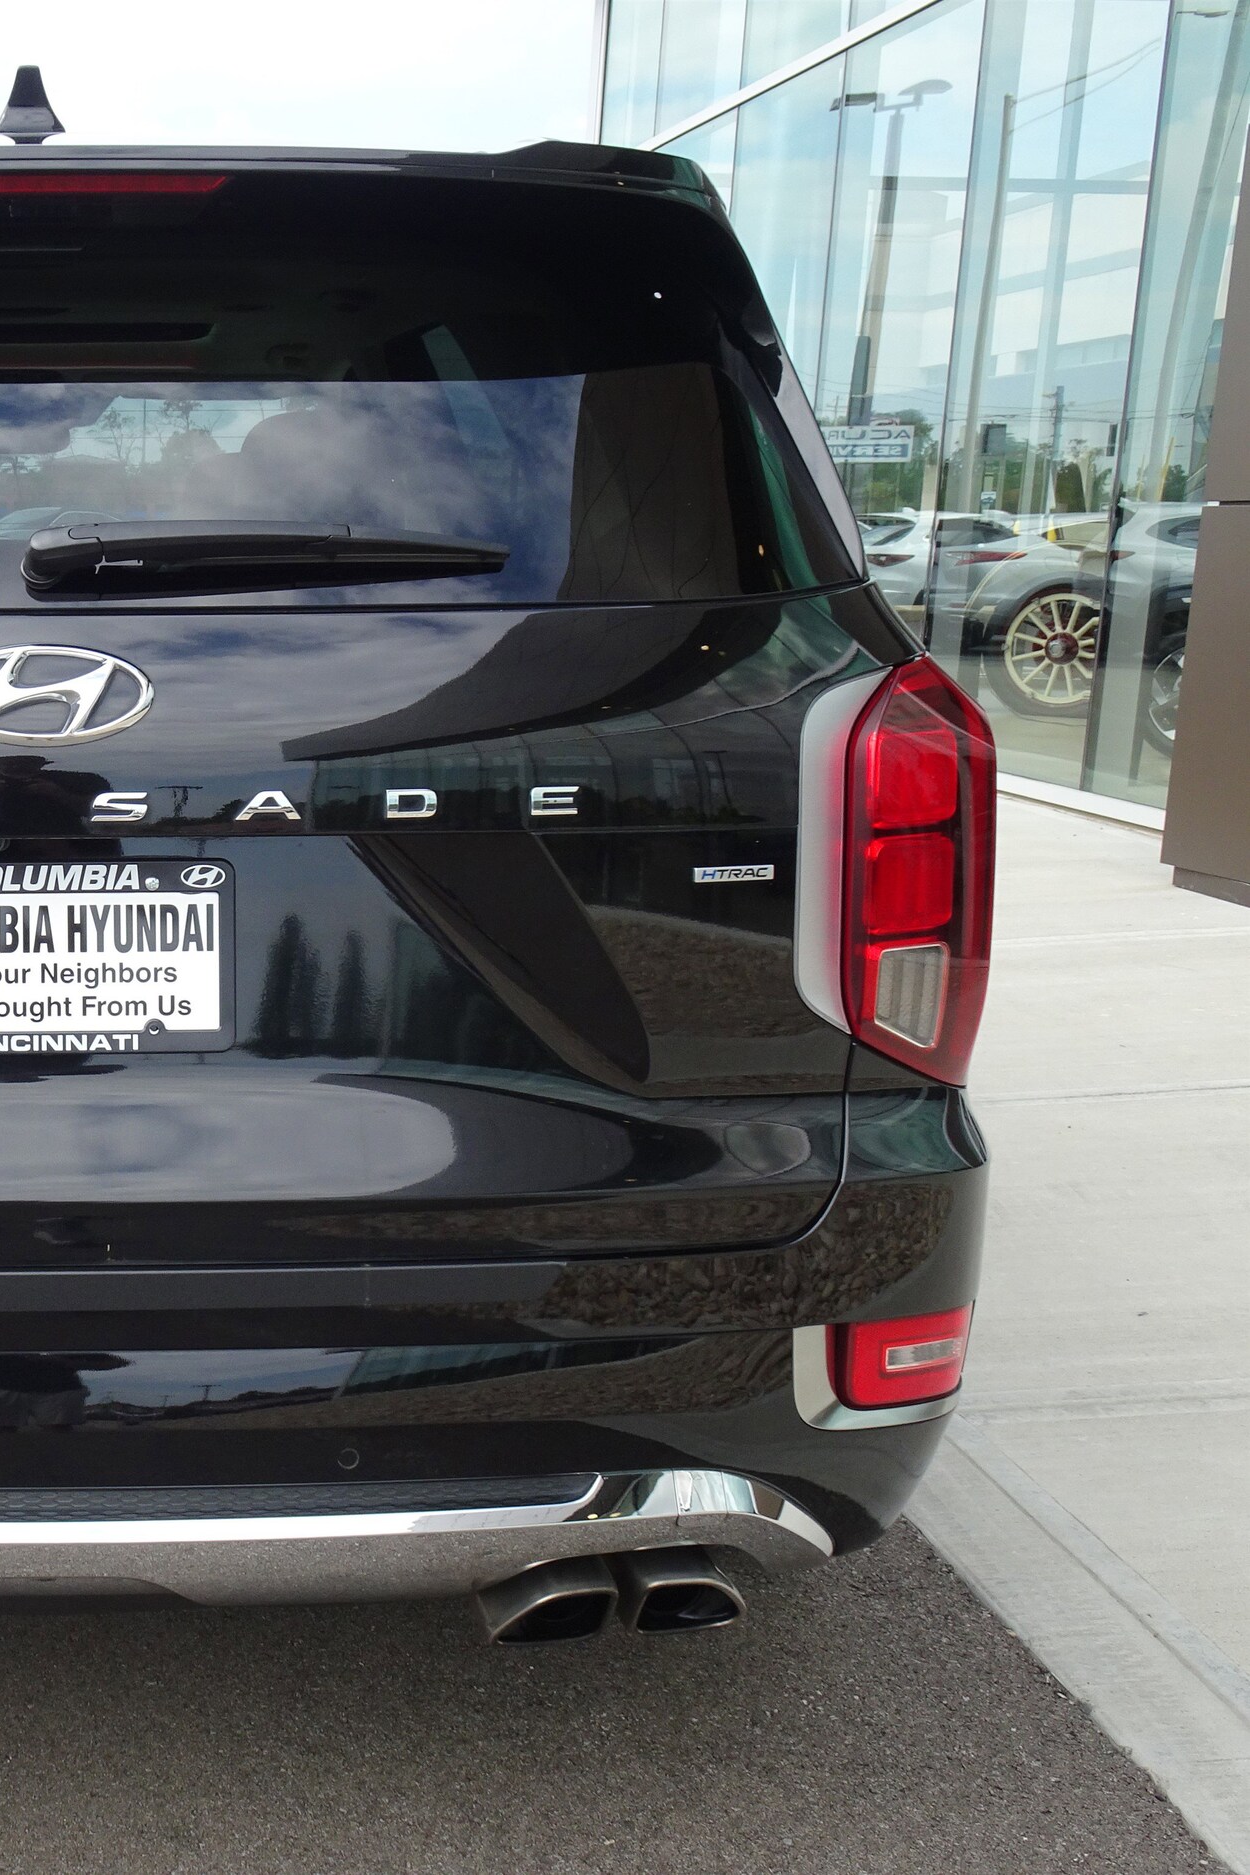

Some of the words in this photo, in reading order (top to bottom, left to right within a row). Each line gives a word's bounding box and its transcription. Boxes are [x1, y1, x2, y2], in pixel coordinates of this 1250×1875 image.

[701, 867, 768, 880] HTRAC
[67, 903, 214, 953] HYUNDAI
[40, 962, 178, 989] Neighbors
[82, 995, 148, 1016] From
[158, 995, 192, 1016] Us
